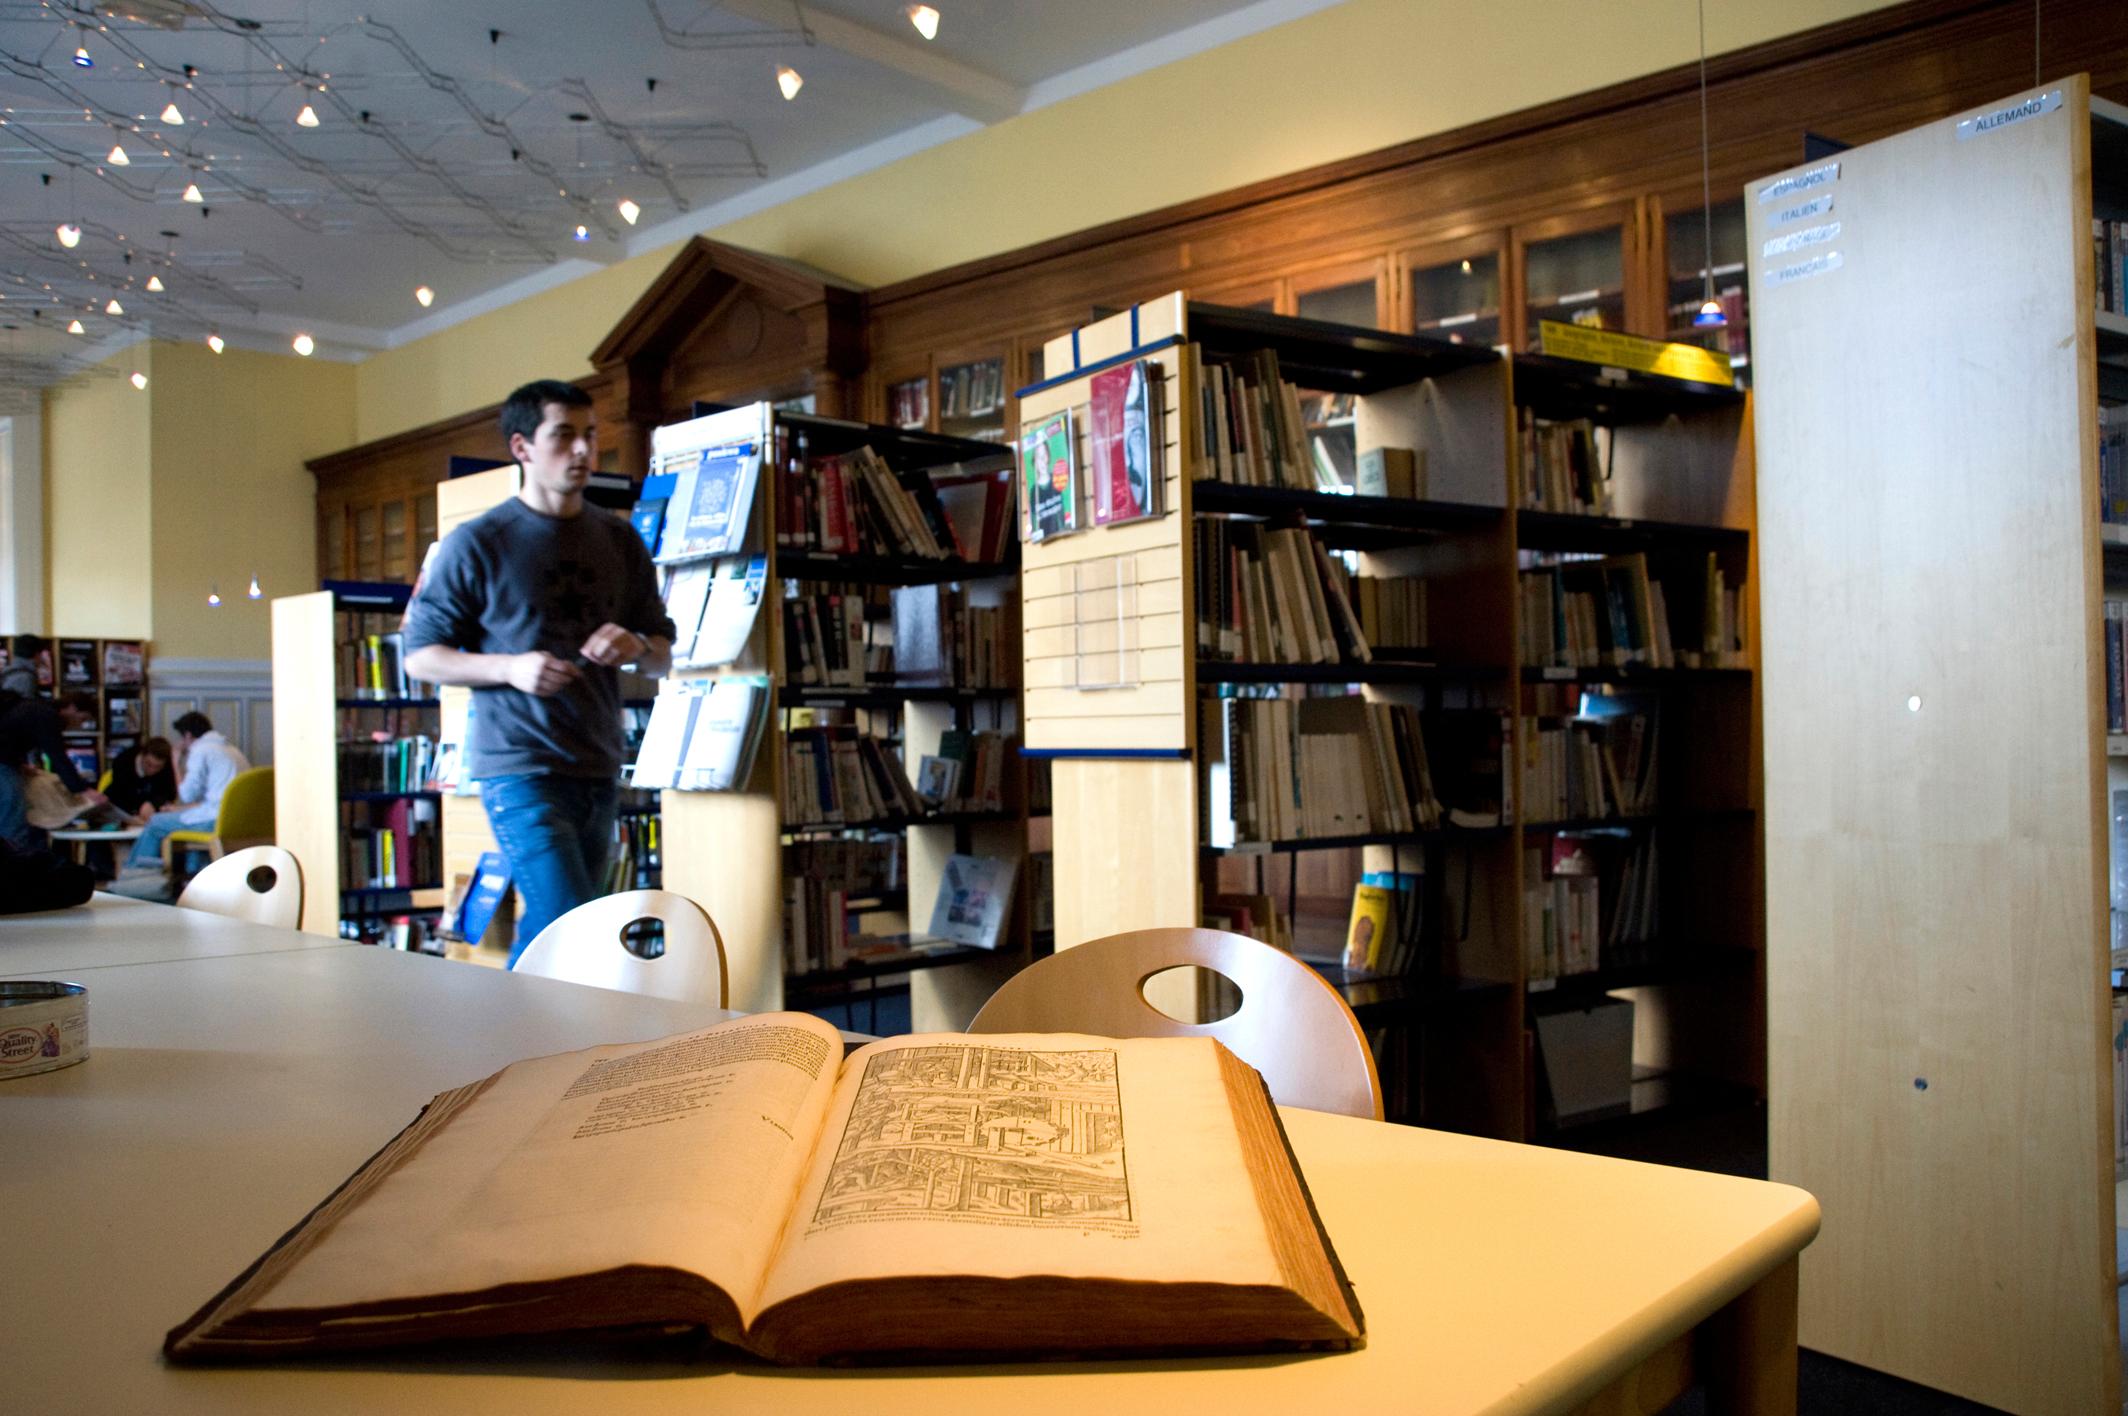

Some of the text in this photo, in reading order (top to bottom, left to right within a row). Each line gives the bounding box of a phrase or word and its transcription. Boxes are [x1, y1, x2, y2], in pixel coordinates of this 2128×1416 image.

[1976, 102, 2042, 132] ALLEMAND
[1773, 173, 1824, 196] ESPAGNOL
[1780, 203, 1818, 222] ITALIEN
[1, 1046, 34, 1058] Street
